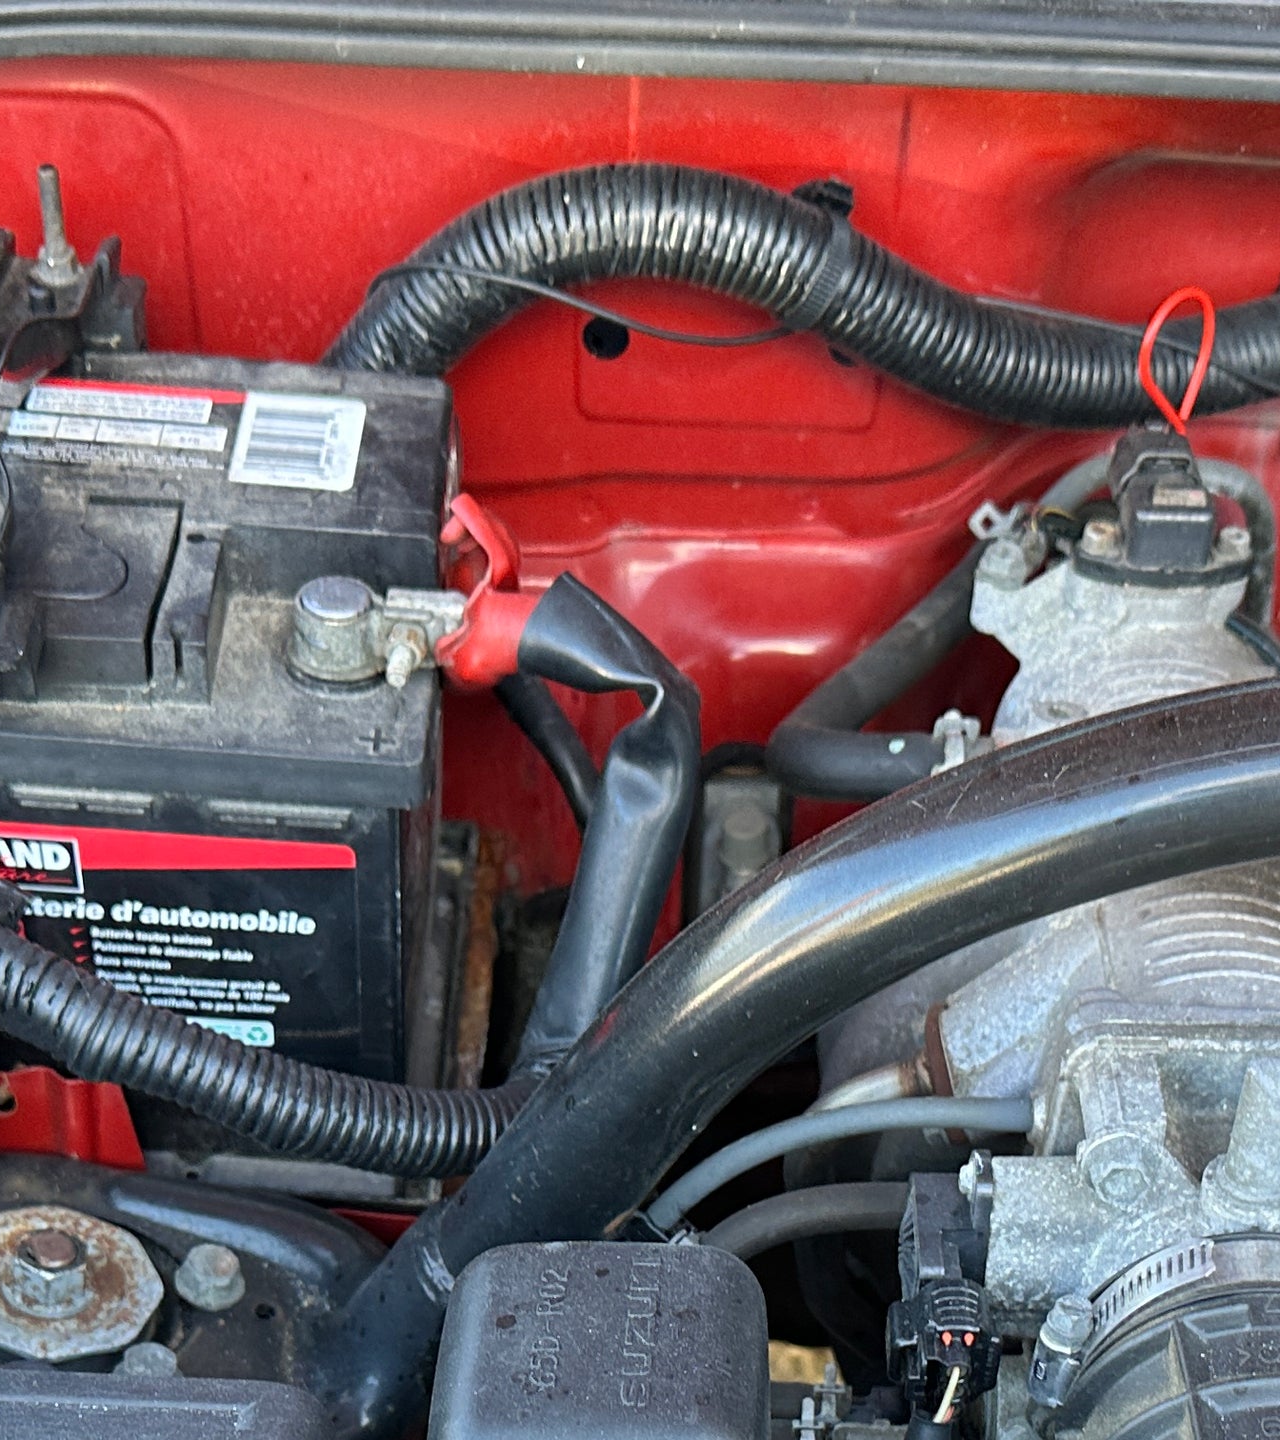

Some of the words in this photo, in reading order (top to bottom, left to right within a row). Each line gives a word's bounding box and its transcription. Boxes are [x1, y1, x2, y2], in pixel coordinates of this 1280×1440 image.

[23, 896, 106, 921] terie
[110, 900, 317, 936] d'automobile
[619, 1255, 662, 1408] SUZUKI
